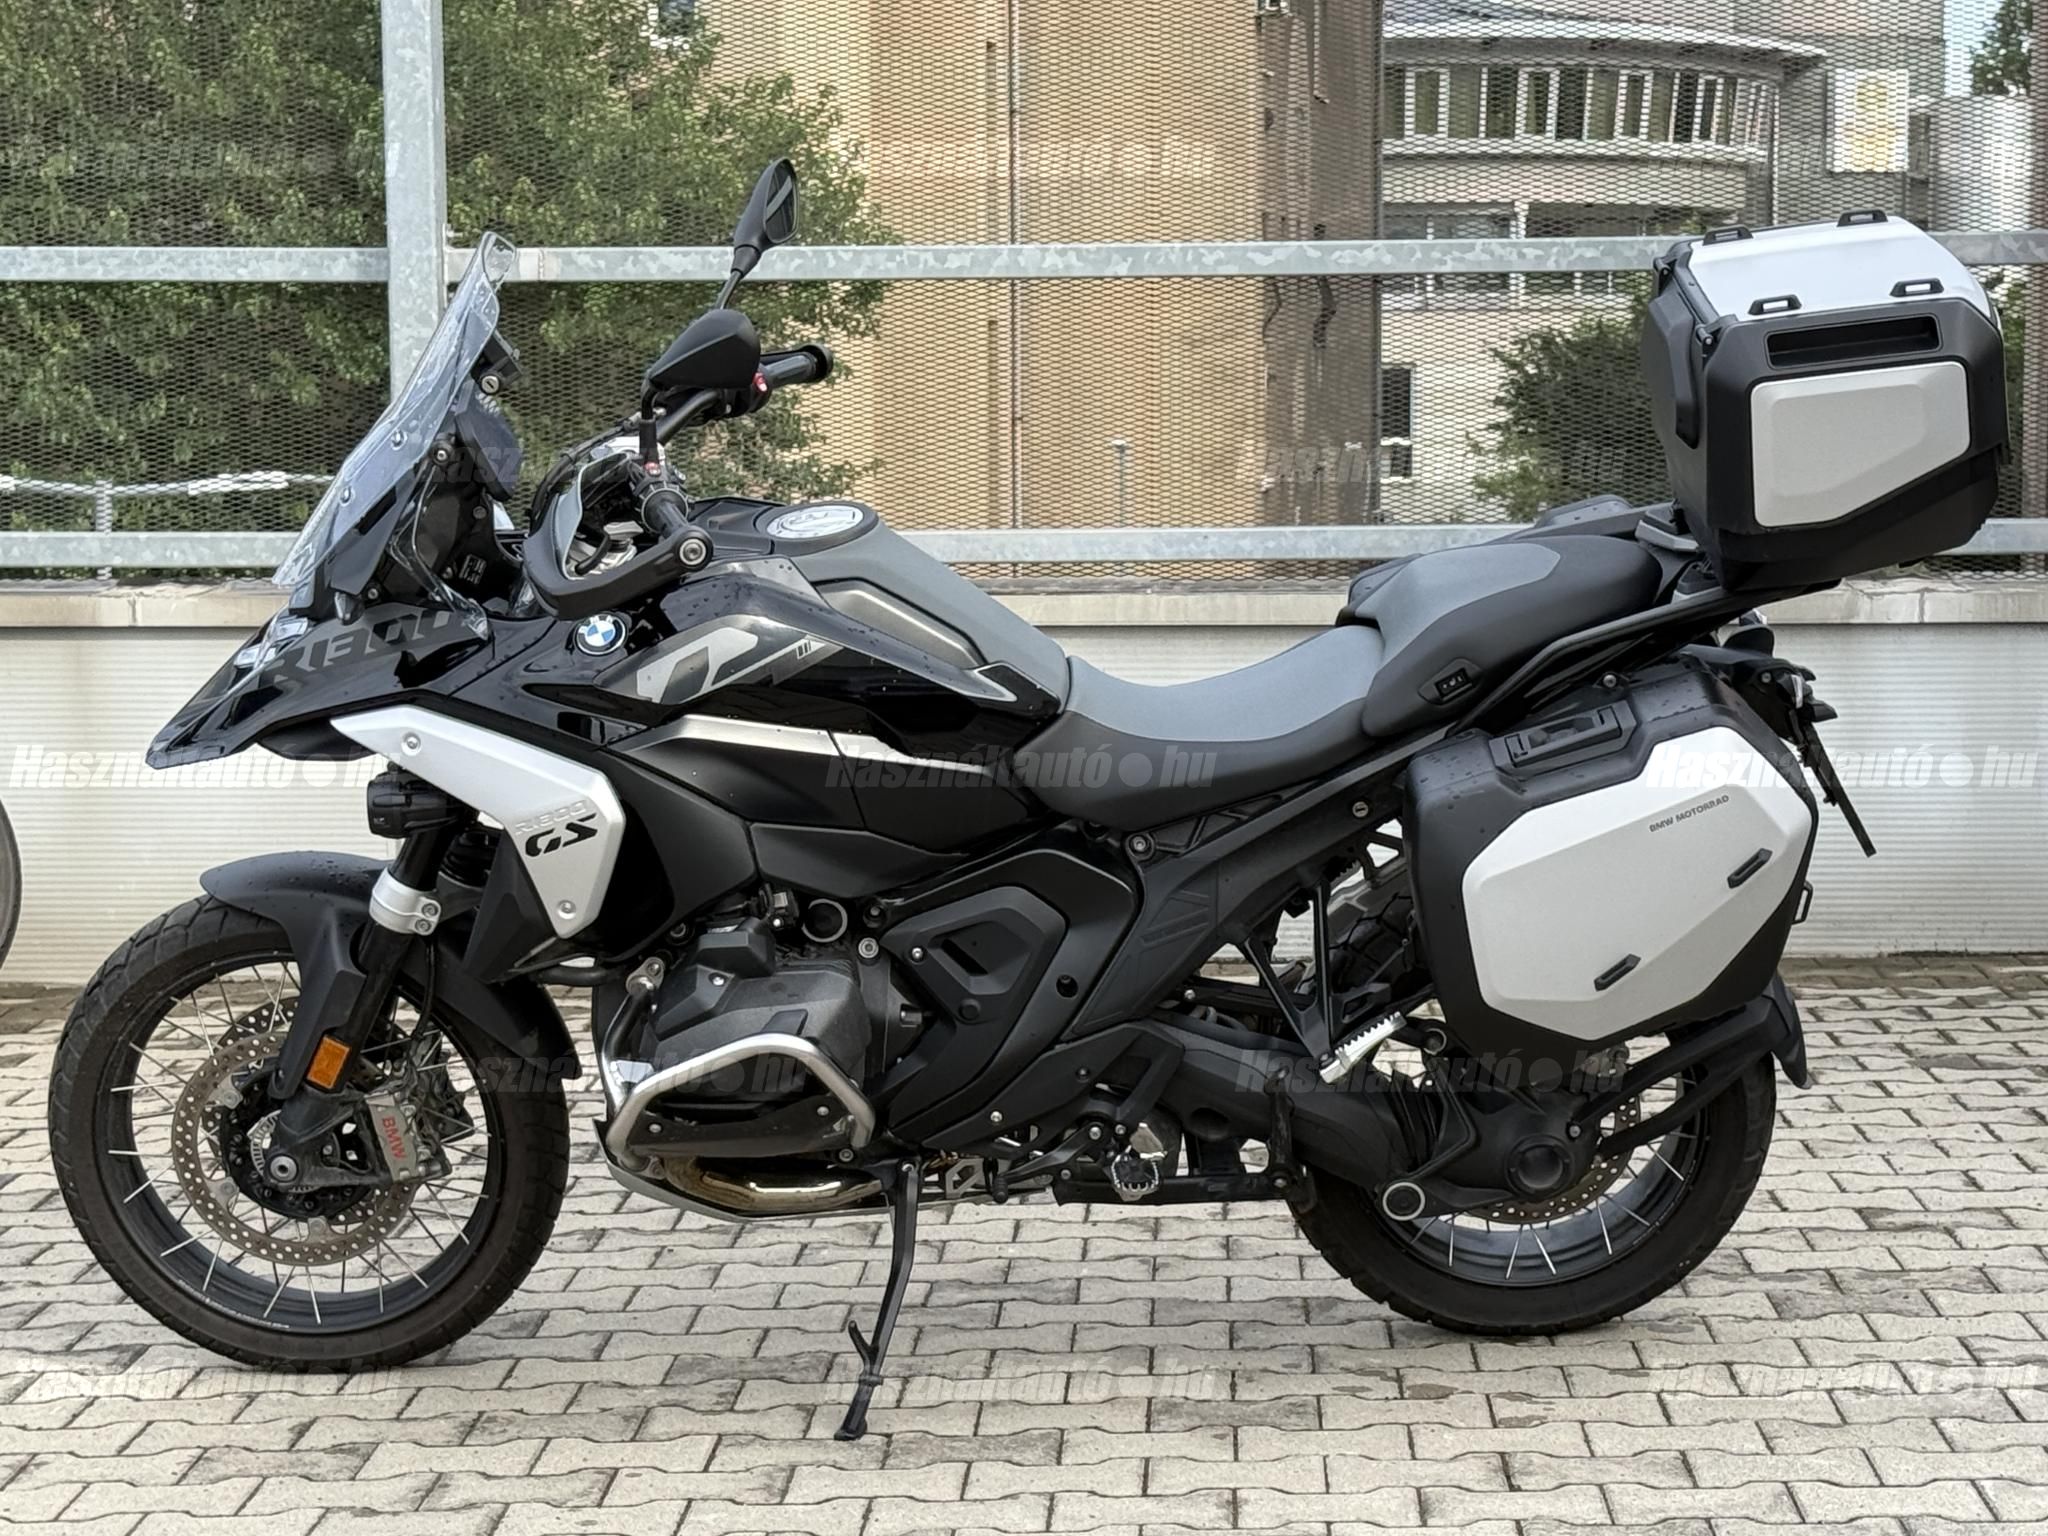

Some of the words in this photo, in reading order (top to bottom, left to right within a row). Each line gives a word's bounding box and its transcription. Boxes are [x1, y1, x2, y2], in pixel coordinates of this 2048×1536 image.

[525, 812, 598, 857] GS
[1649, 817, 1673, 833] BMW
[1675, 794, 1730, 822] MOTORRAD
[383, 1115, 407, 1160] BMW
